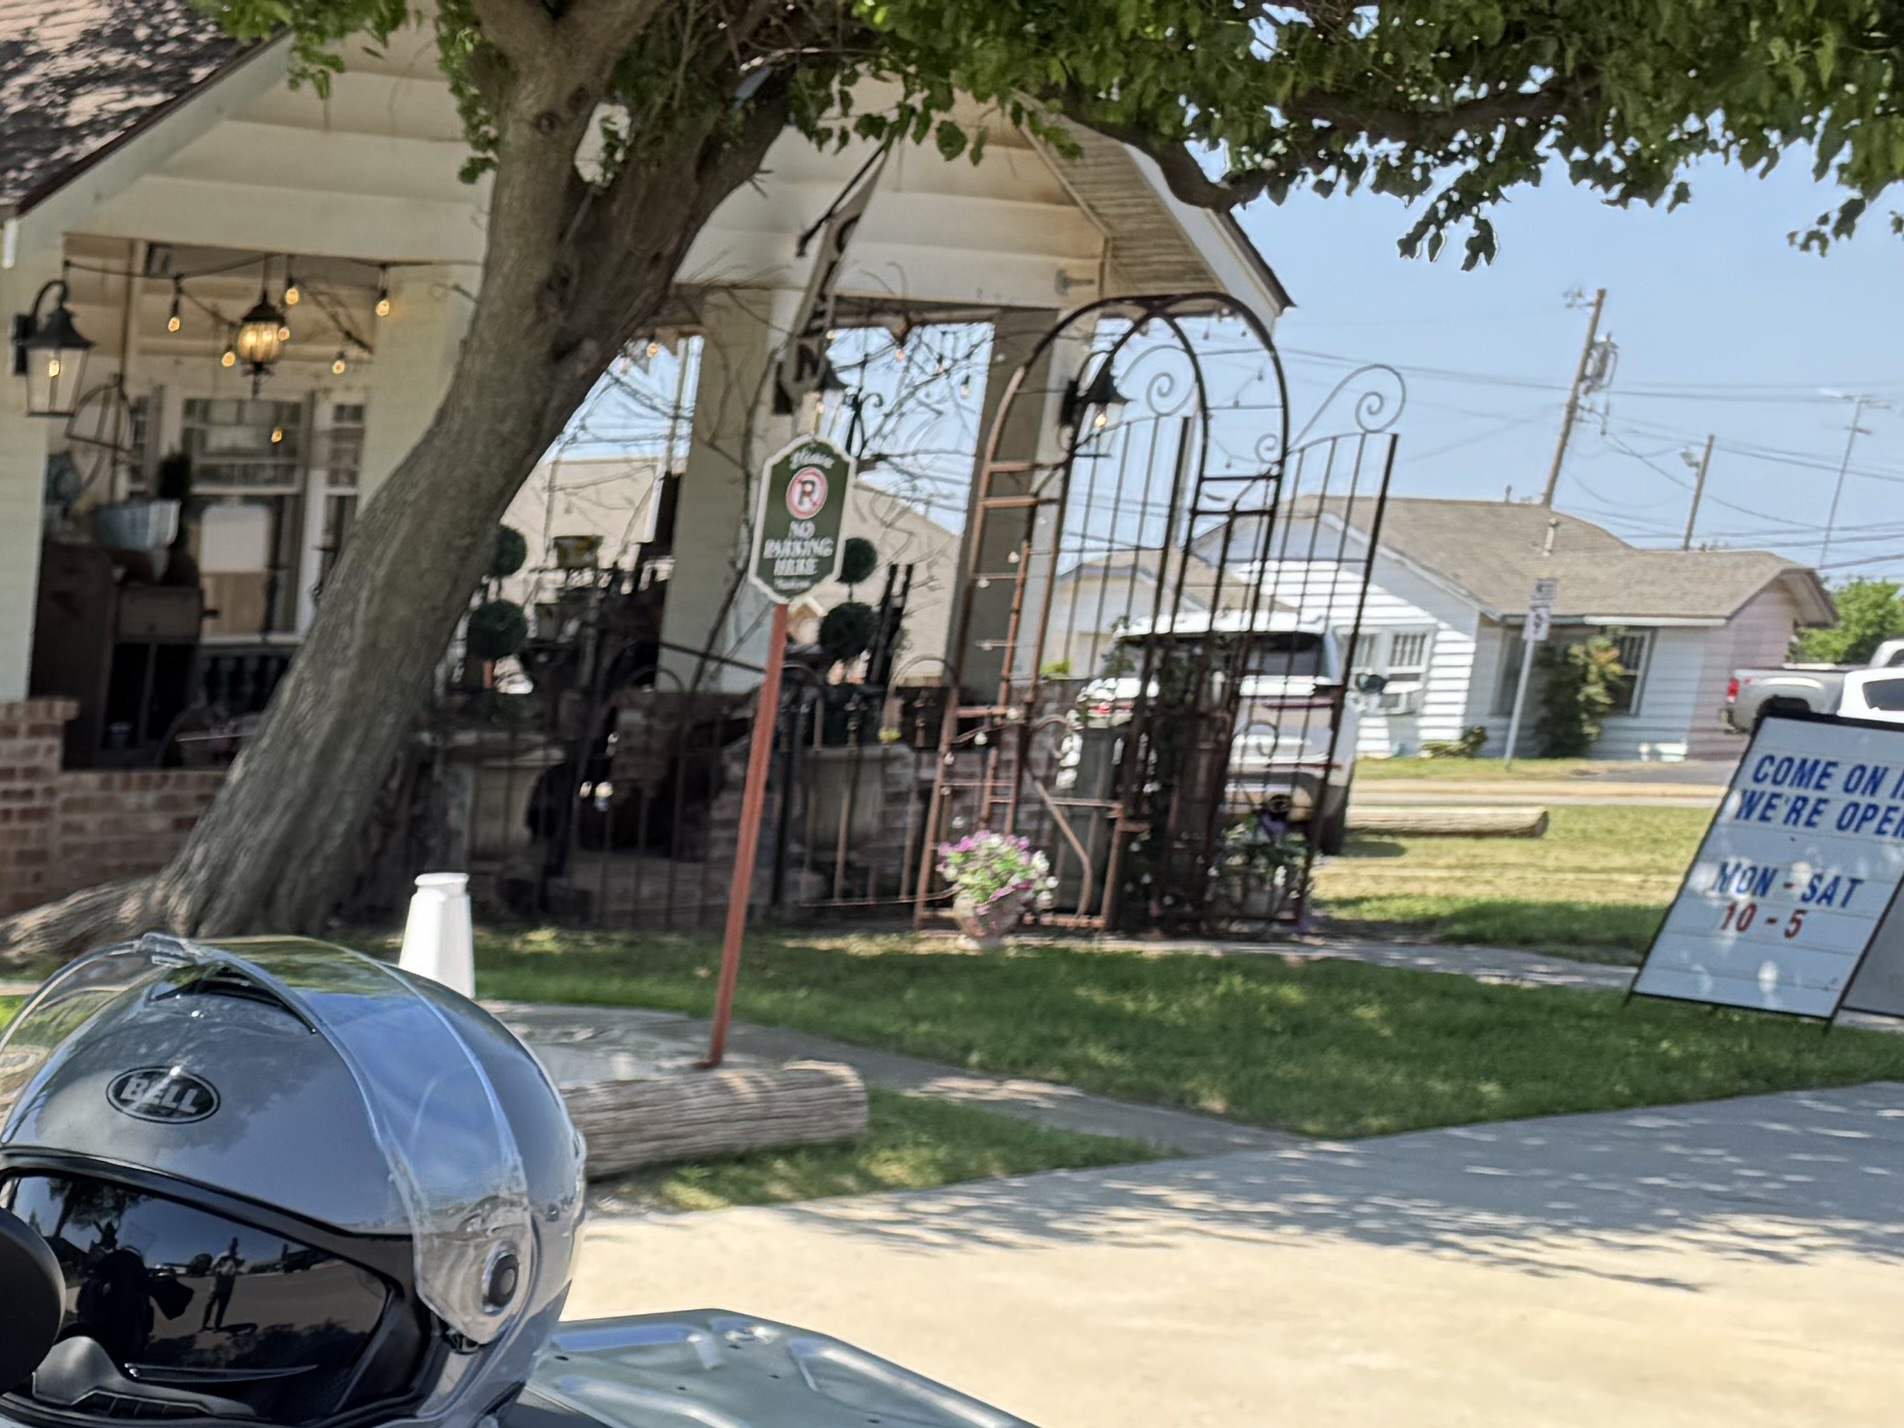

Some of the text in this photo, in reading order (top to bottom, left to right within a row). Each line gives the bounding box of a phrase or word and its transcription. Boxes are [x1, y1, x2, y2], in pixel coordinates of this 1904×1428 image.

[763, 536, 834, 559] PARKING
[789, 520, 816, 539] NO
[774, 557, 819, 577] HERE
[1752, 754, 1840, 791] COME
[1842, 764, 1890, 798] ON
[1734, 788, 1831, 828] WE'RE
[1711, 861, 1779, 898] MON
[1801, 872, 1865, 908] SAT
[1720, 902, 1757, 933] 10
[1784, 909, 1808, 939] 5
[119, 1075, 199, 1115] BELL
